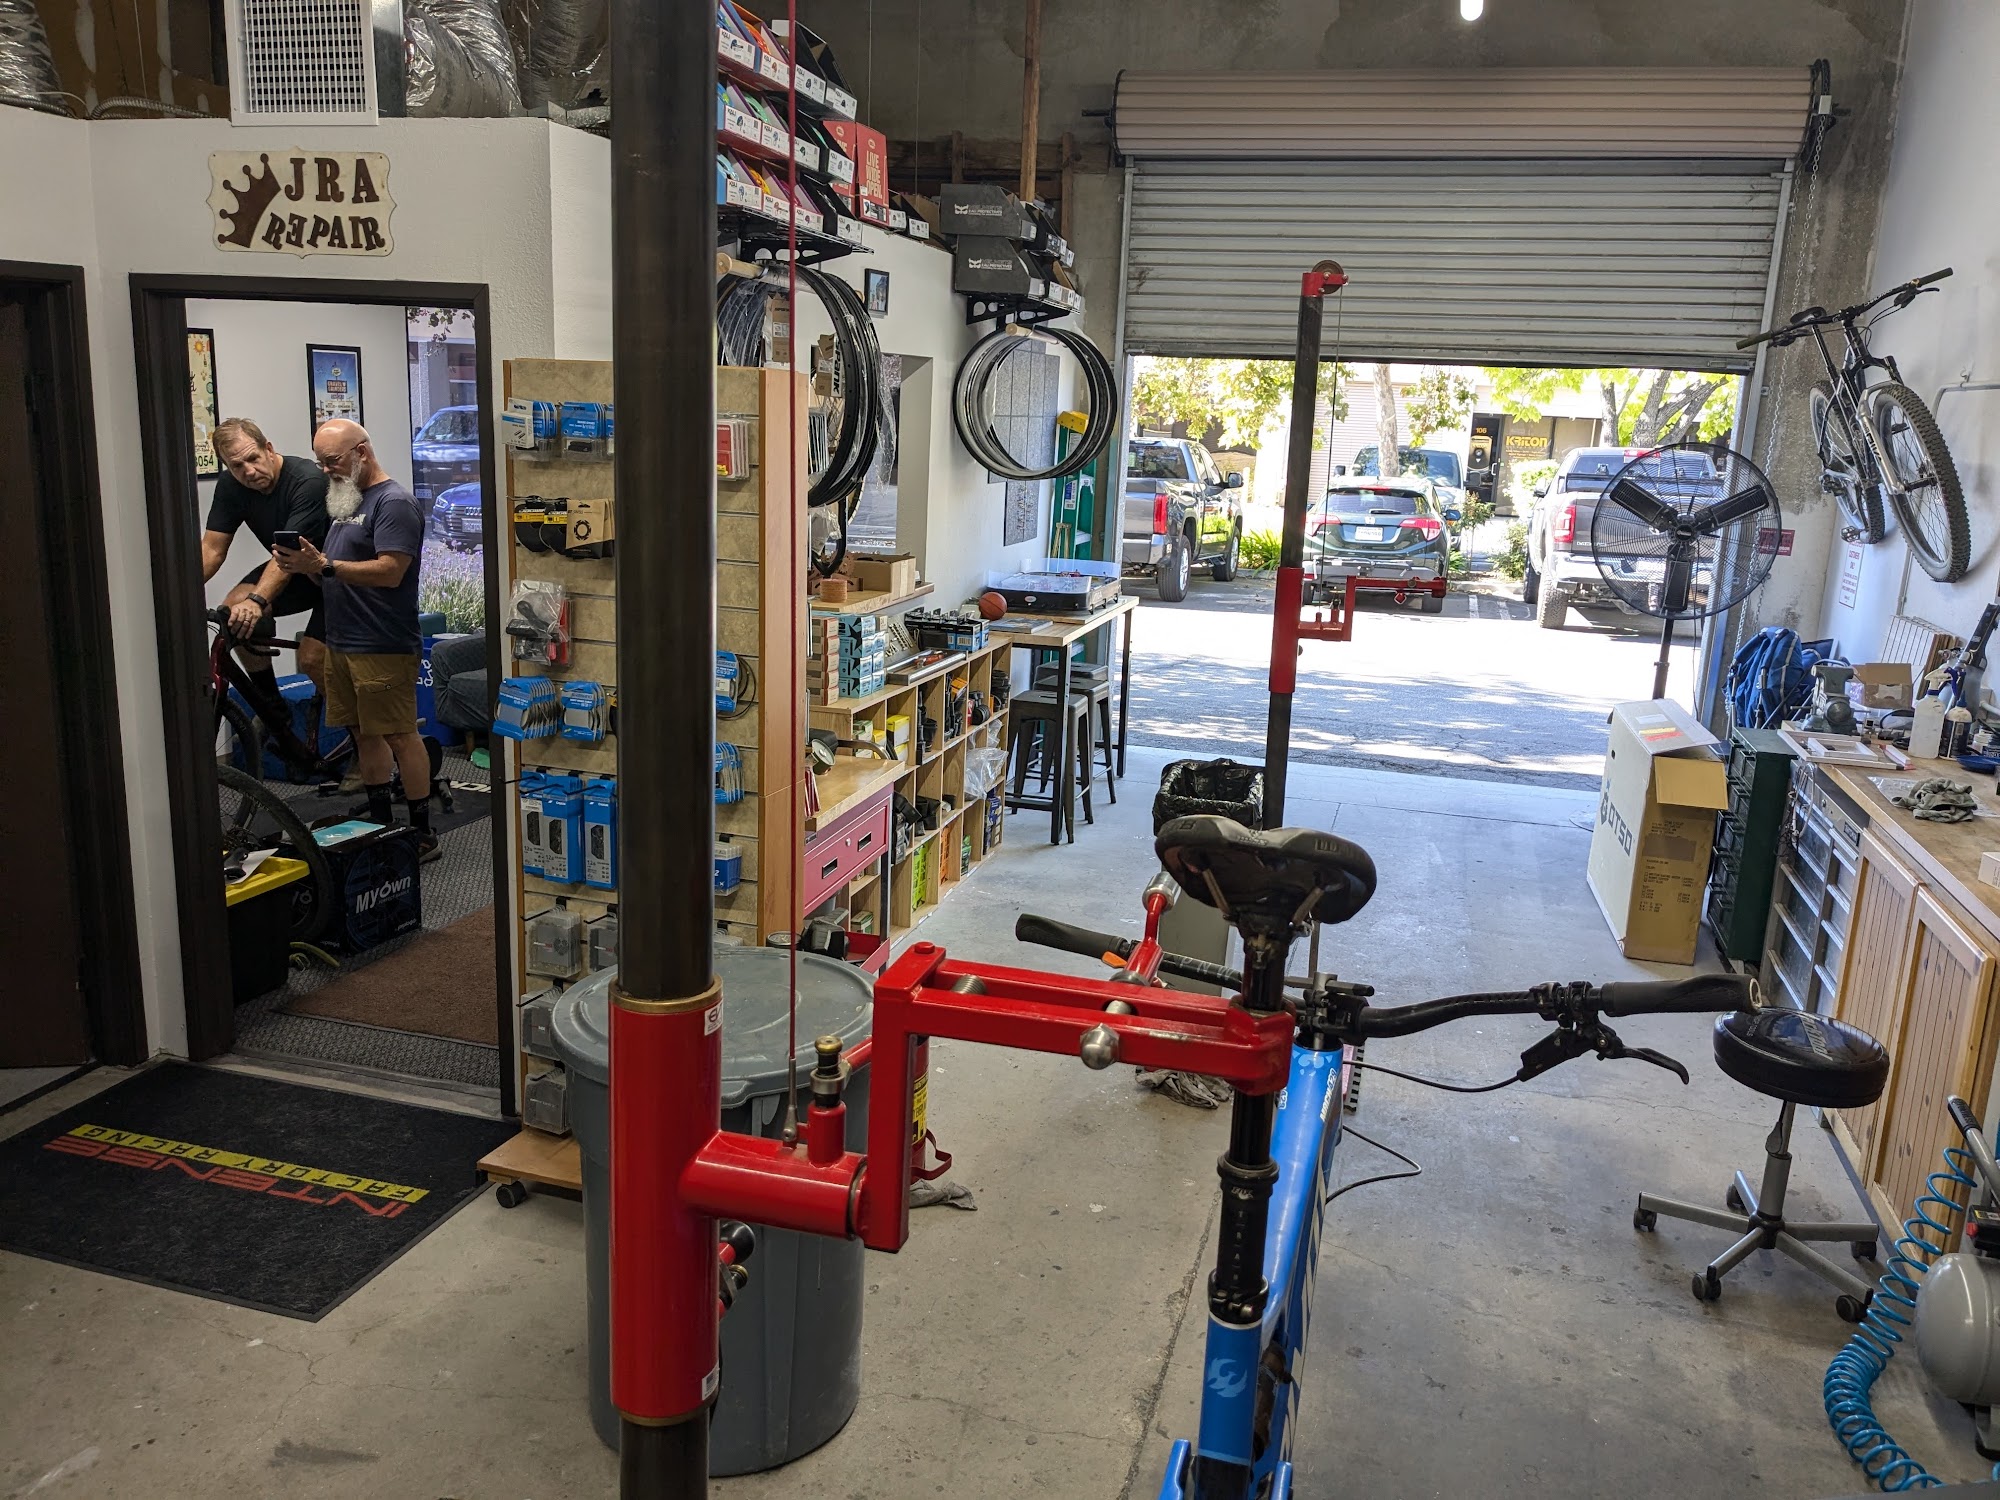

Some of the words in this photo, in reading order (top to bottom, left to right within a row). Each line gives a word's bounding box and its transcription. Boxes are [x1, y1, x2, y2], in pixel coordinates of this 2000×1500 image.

[284, 157, 380, 204] JRA
[866, 150, 880, 167] LIVE
[261, 212, 386, 251] REPAIR
[1608, 801, 1633, 857] OTSO
[81, 1125, 213, 1162] RACING
[42, 1134, 410, 1219] INTENSE
[234, 1155, 426, 1203] FACTORY
